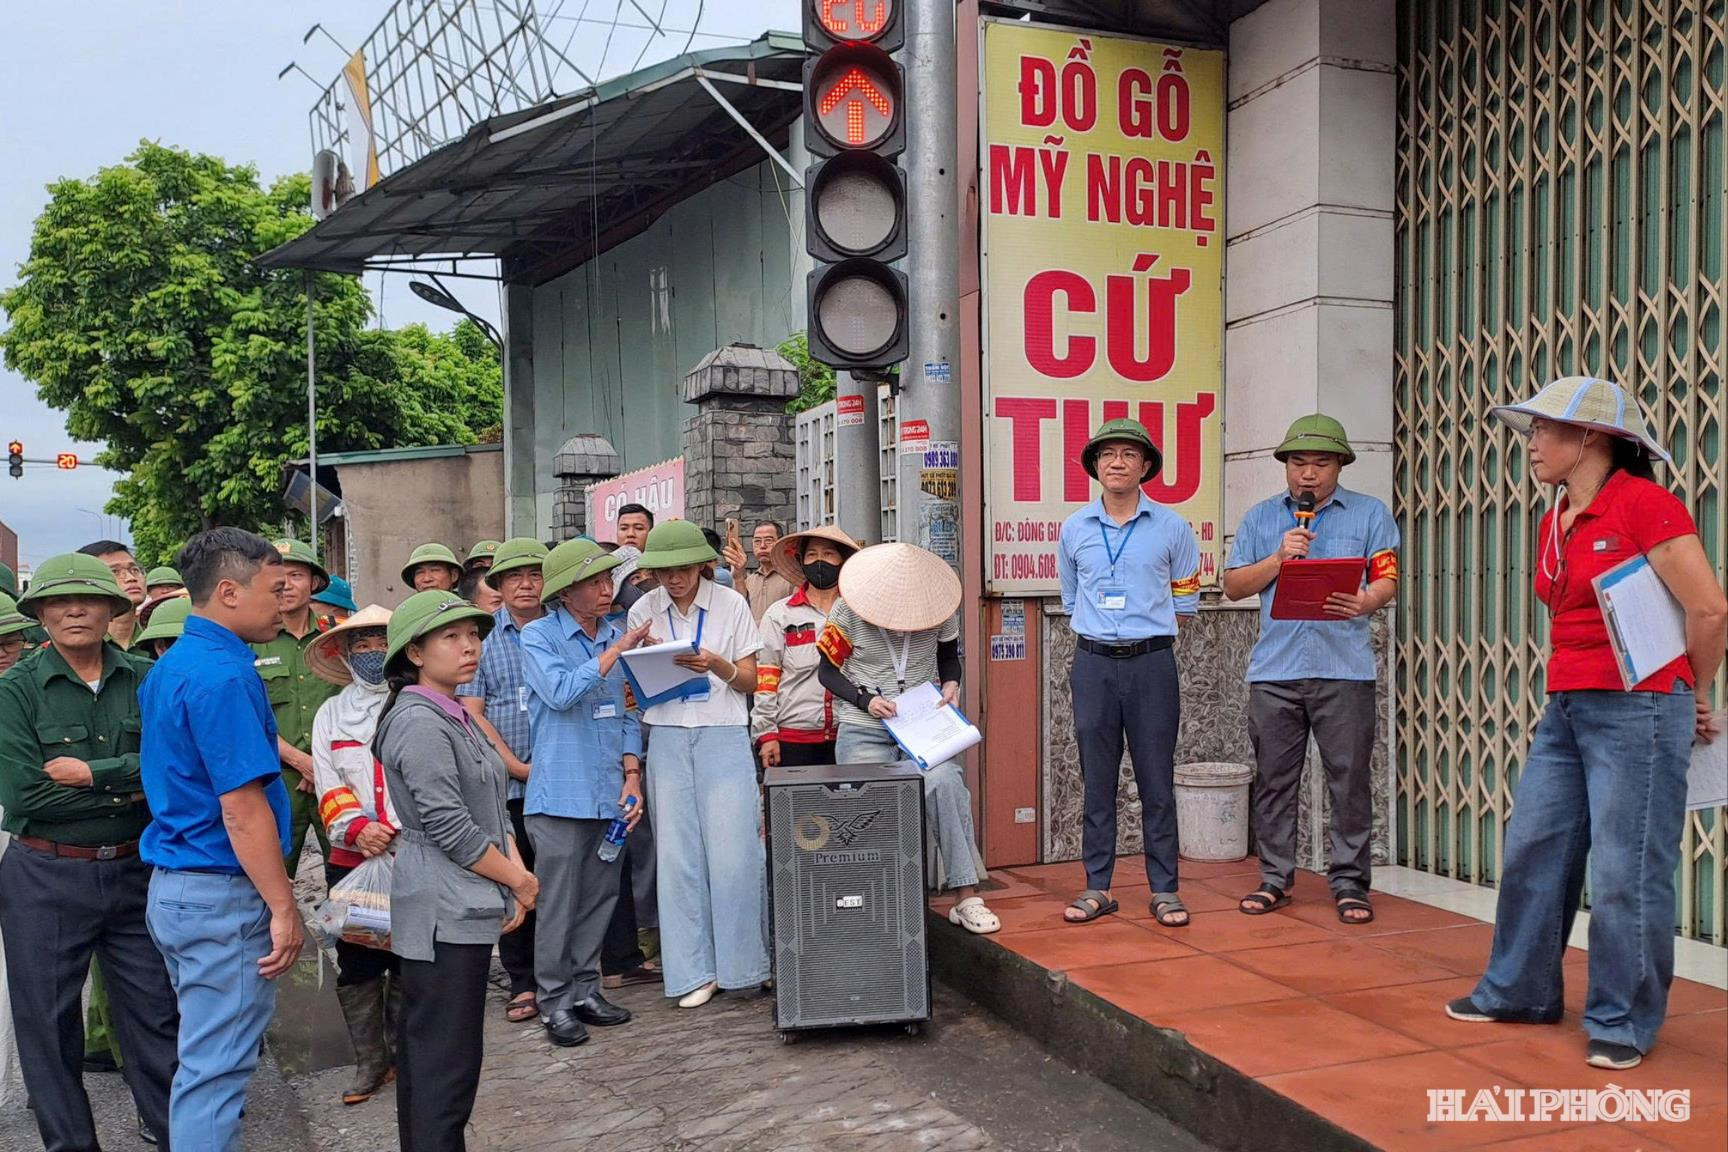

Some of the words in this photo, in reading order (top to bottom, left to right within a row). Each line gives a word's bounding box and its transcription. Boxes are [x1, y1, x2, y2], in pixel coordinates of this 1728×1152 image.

[1019, 38, 1097, 132] ĐỒ
[1118, 47, 1190, 142] GỖ
[989, 134, 1069, 218] MỸ
[1087, 150, 1215, 247] NGHỆ
[1024, 253, 1191, 382] CỨ
[59, 455, 75, 468] 20
[995, 521, 1014, 543] Đ/C:
[1018, 517, 1045, 542] ĐÔNG
[994, 553, 1009, 579] ĐT:
[815, 851, 879, 863] Premium
